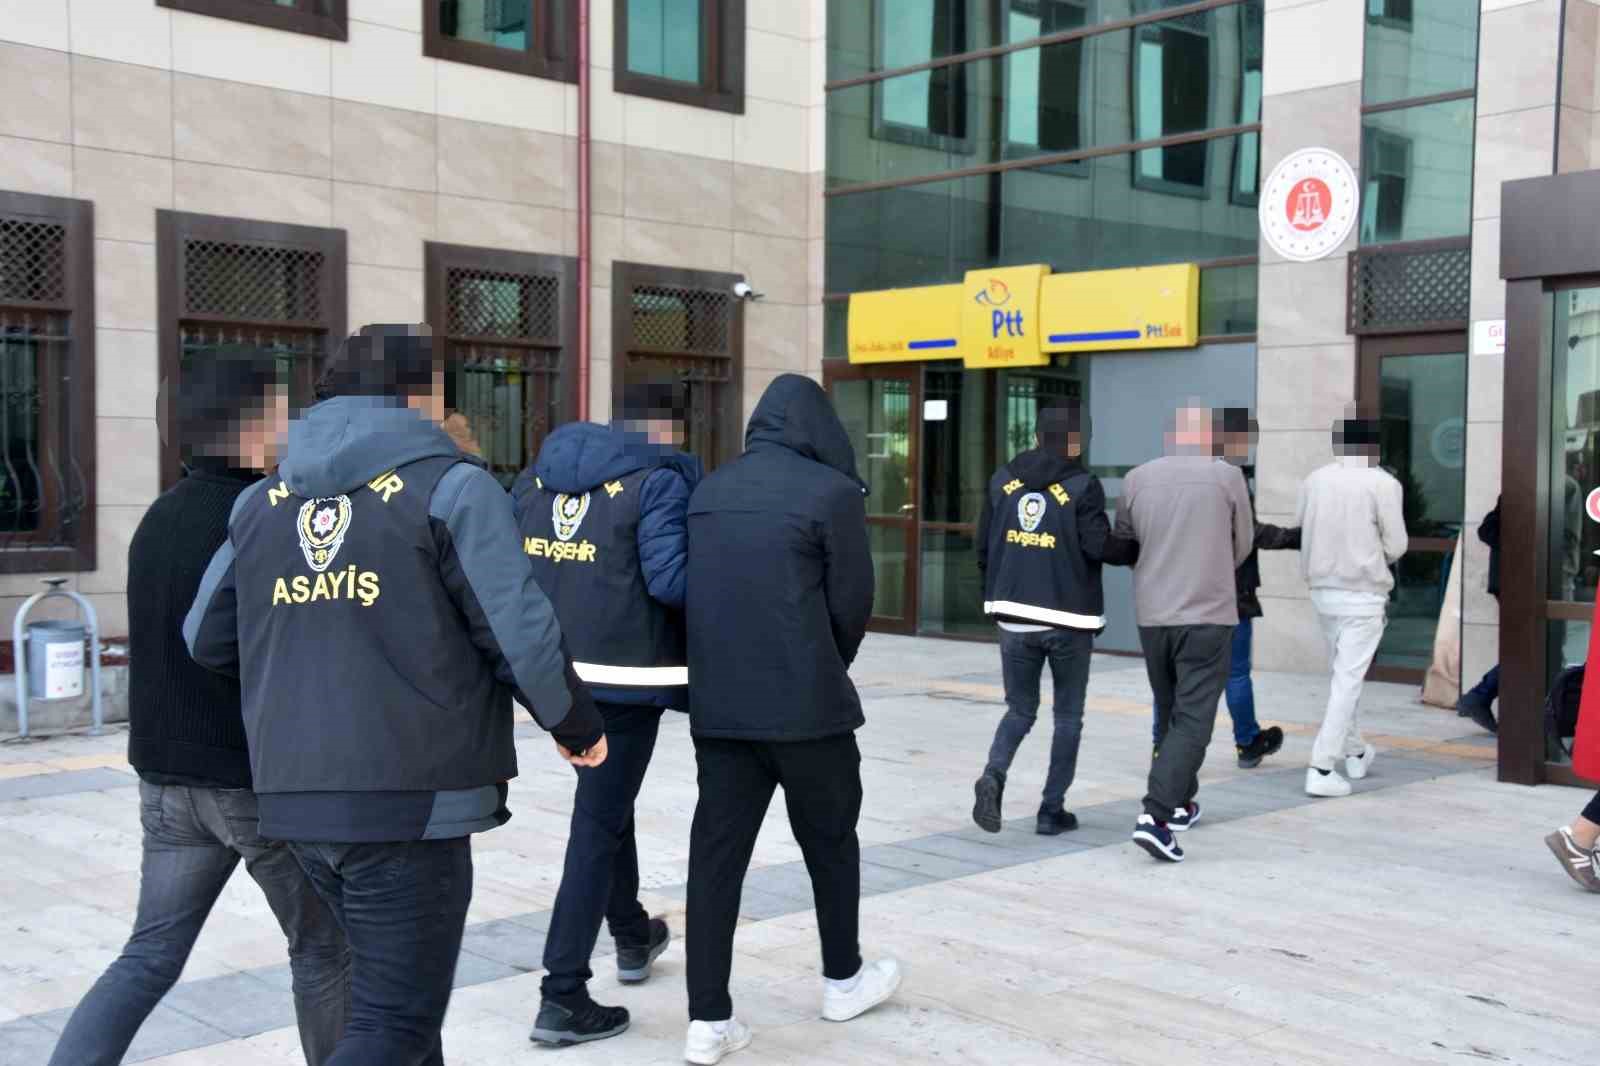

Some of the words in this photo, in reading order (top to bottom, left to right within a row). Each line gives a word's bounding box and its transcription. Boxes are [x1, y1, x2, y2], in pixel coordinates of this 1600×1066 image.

[992, 309, 1024, 338] Ptt
[524, 537, 597, 562] NEVŞEHİR
[272, 565, 380, 607] ASAYİŞ
